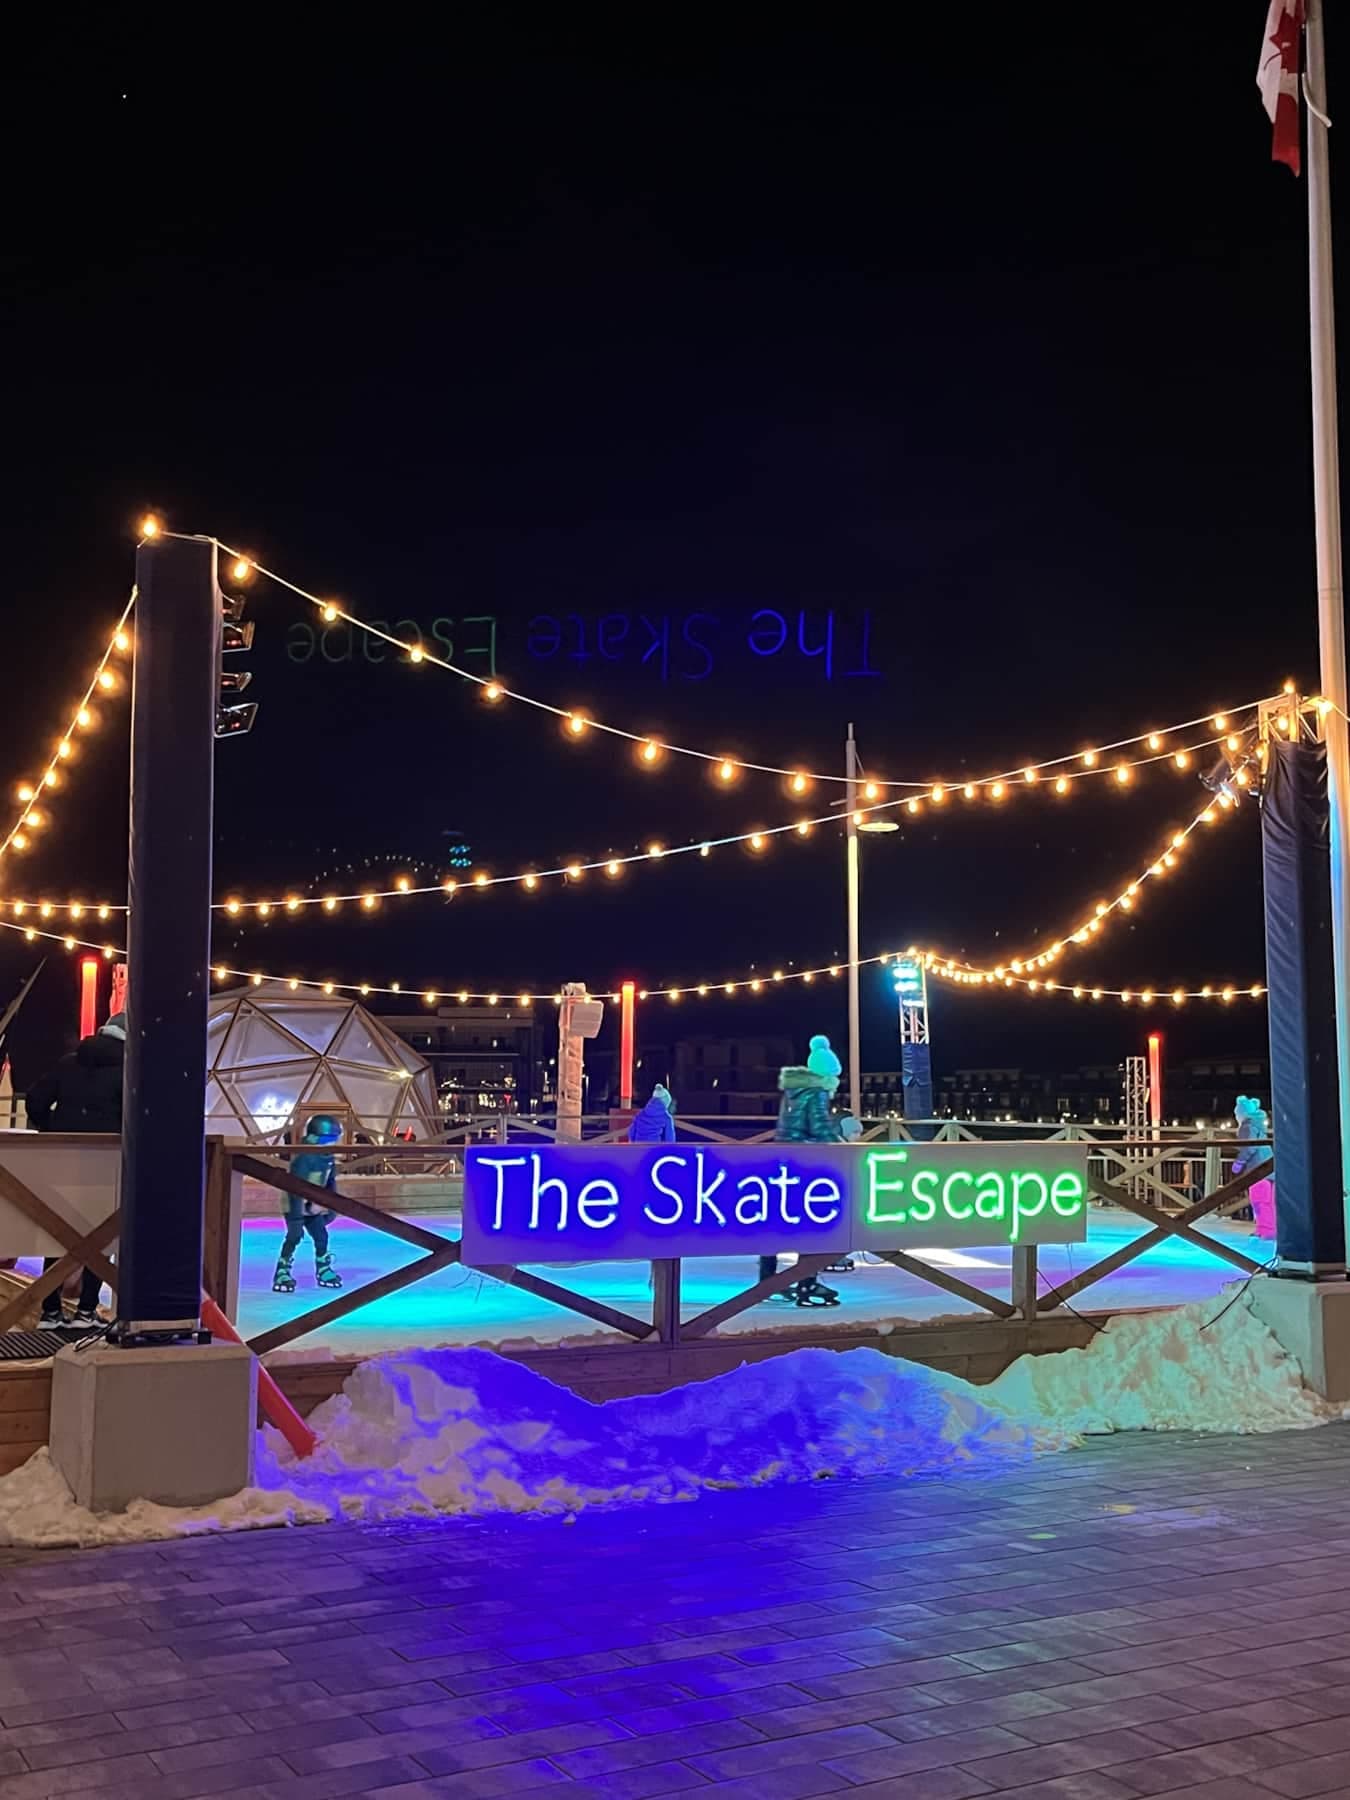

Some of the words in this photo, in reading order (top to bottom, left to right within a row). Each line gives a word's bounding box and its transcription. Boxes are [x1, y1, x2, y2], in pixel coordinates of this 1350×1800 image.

[286, 606, 497, 682] Escape
[528, 612, 718, 682] Skate
[747, 609, 883, 681] The
[476, 1154, 620, 1231] The
[643, 1152, 841, 1227] Skate
[865, 1151, 1084, 1242] Escape
